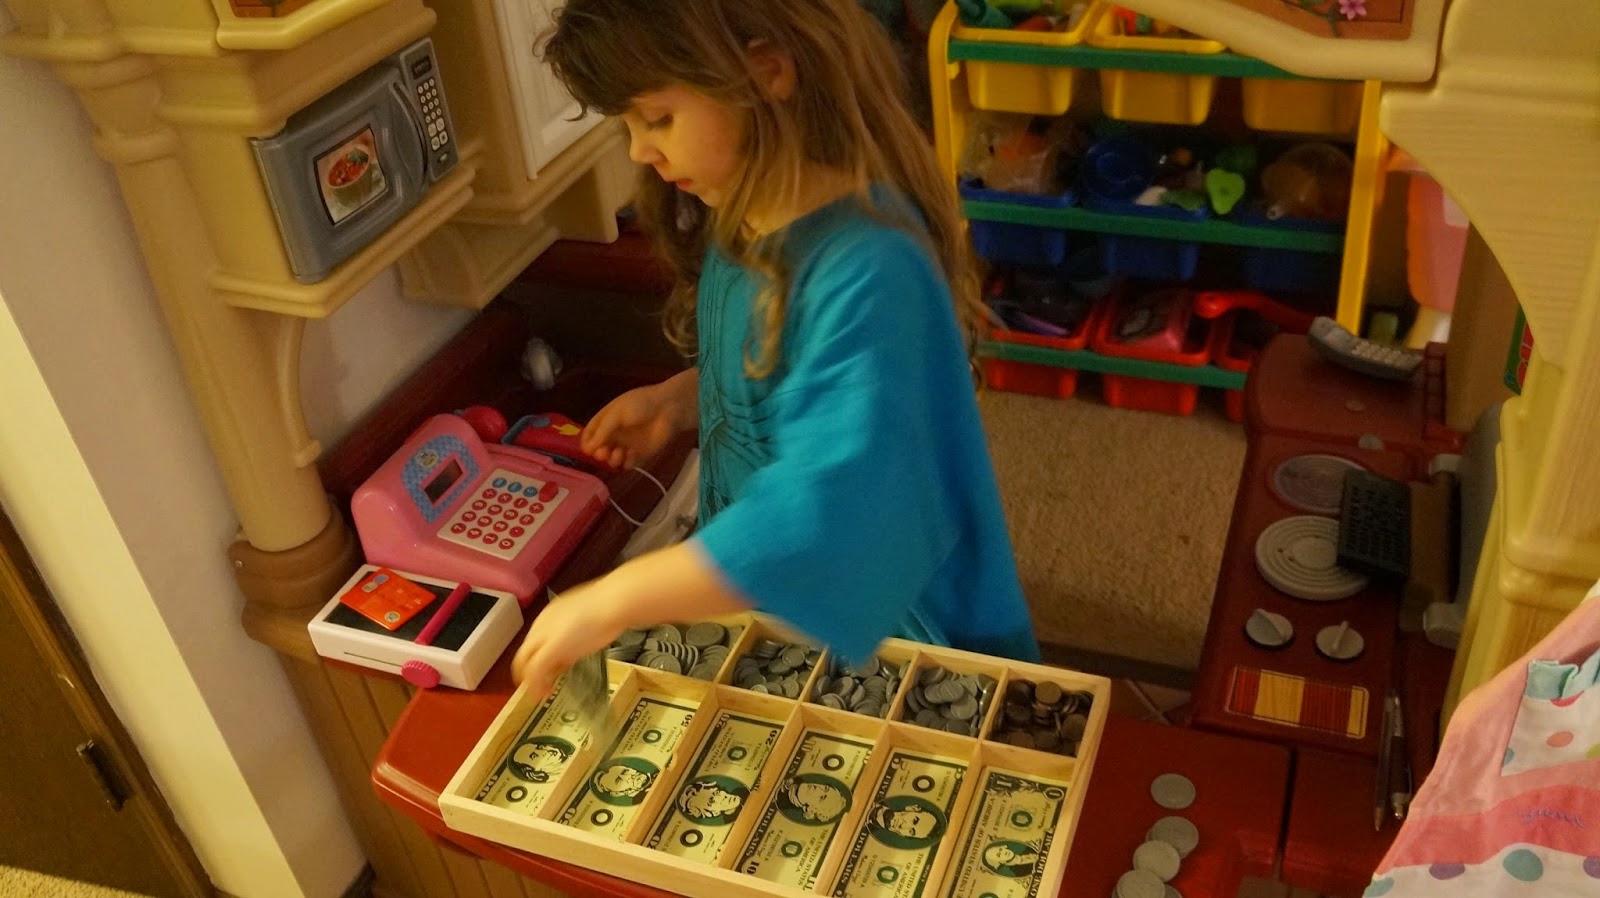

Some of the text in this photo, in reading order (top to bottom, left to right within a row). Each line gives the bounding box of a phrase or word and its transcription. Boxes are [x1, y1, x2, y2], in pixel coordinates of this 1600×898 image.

[679, 712, 694, 727] 50
[715, 713, 731, 729] 20
[763, 728, 779, 746] 20
[875, 773, 892, 798] FIVE
[743, 806, 776, 857] DOLLARS
[958, 866, 973, 891] UNITED
[967, 838, 981, 864] STATES
[980, 797, 996, 827] AMERICA
[744, 859, 761, 875] 10
[838, 831, 867, 883] DOLLARS
[1029, 874, 1041, 896] ONE
[1035, 834, 1053, 873] DOLLAR
